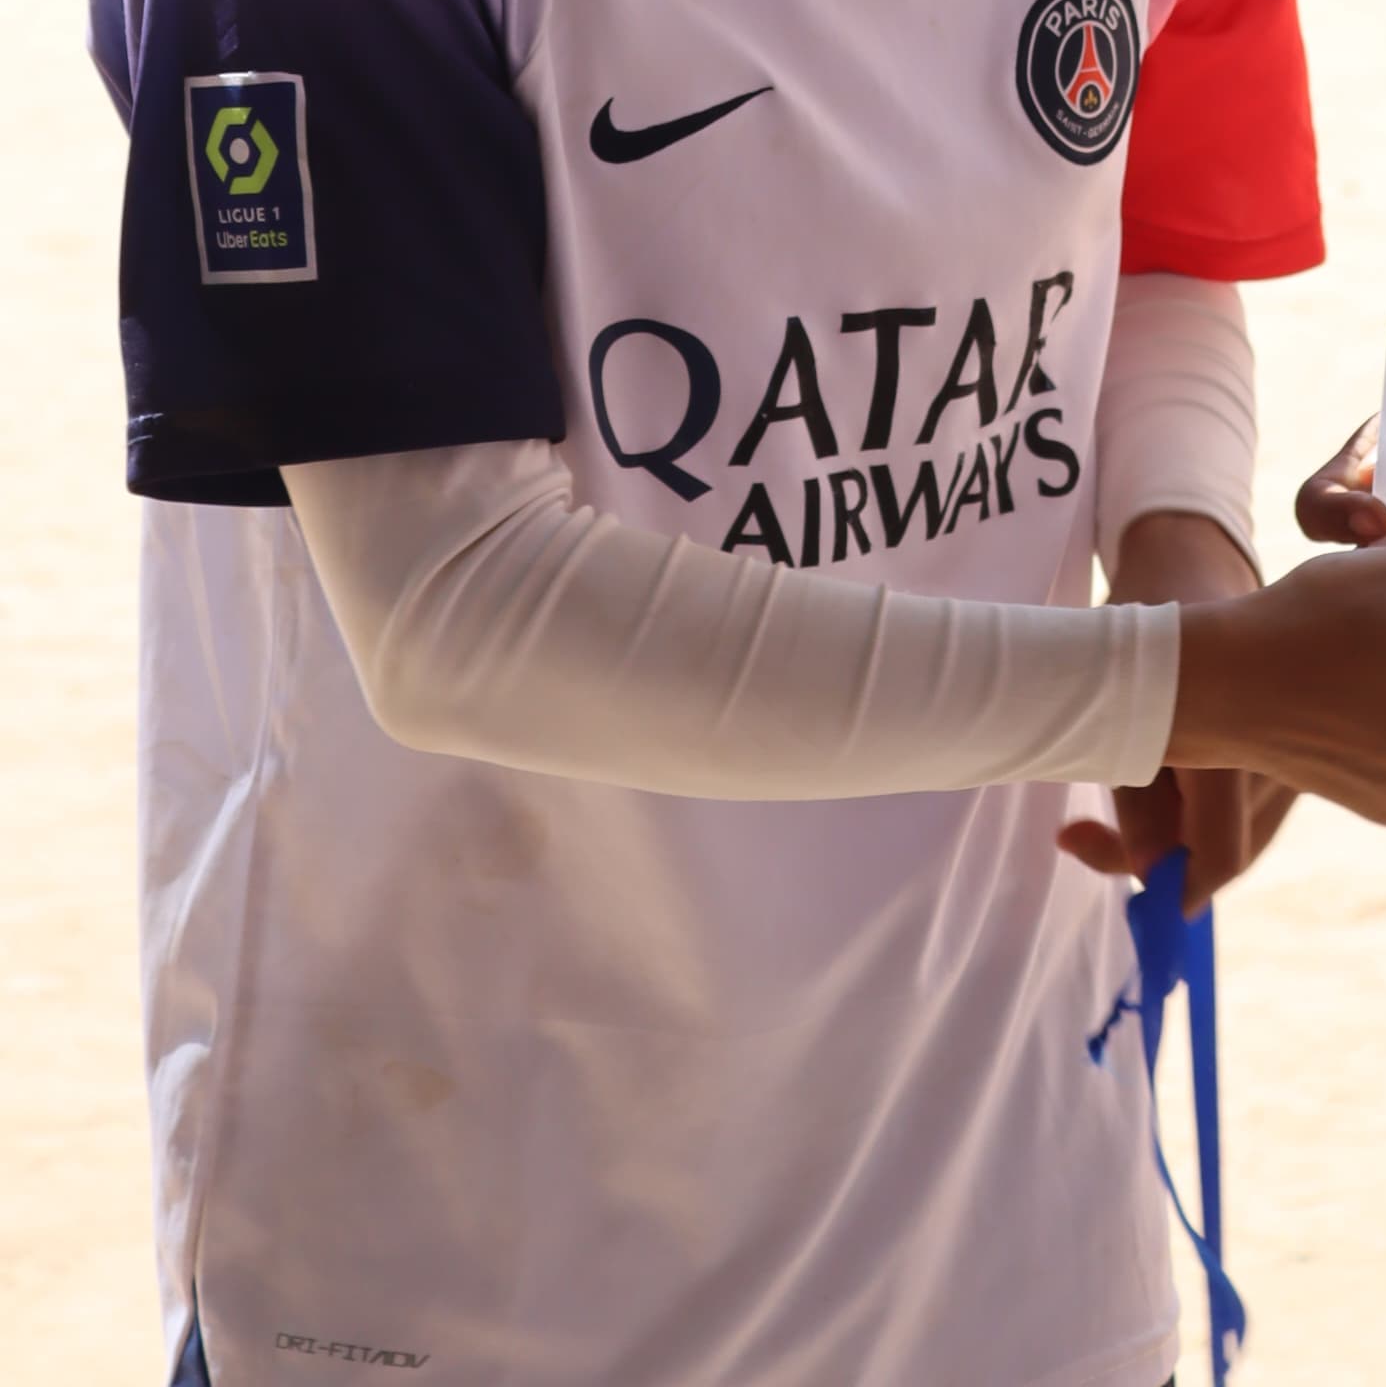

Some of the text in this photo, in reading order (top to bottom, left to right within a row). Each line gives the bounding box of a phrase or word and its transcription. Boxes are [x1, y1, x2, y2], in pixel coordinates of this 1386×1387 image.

[217, 206, 281, 224] LIGUE 1
[588, 271, 1075, 503] QATAR
[720, 408, 1081, 569] AIRWAYS
